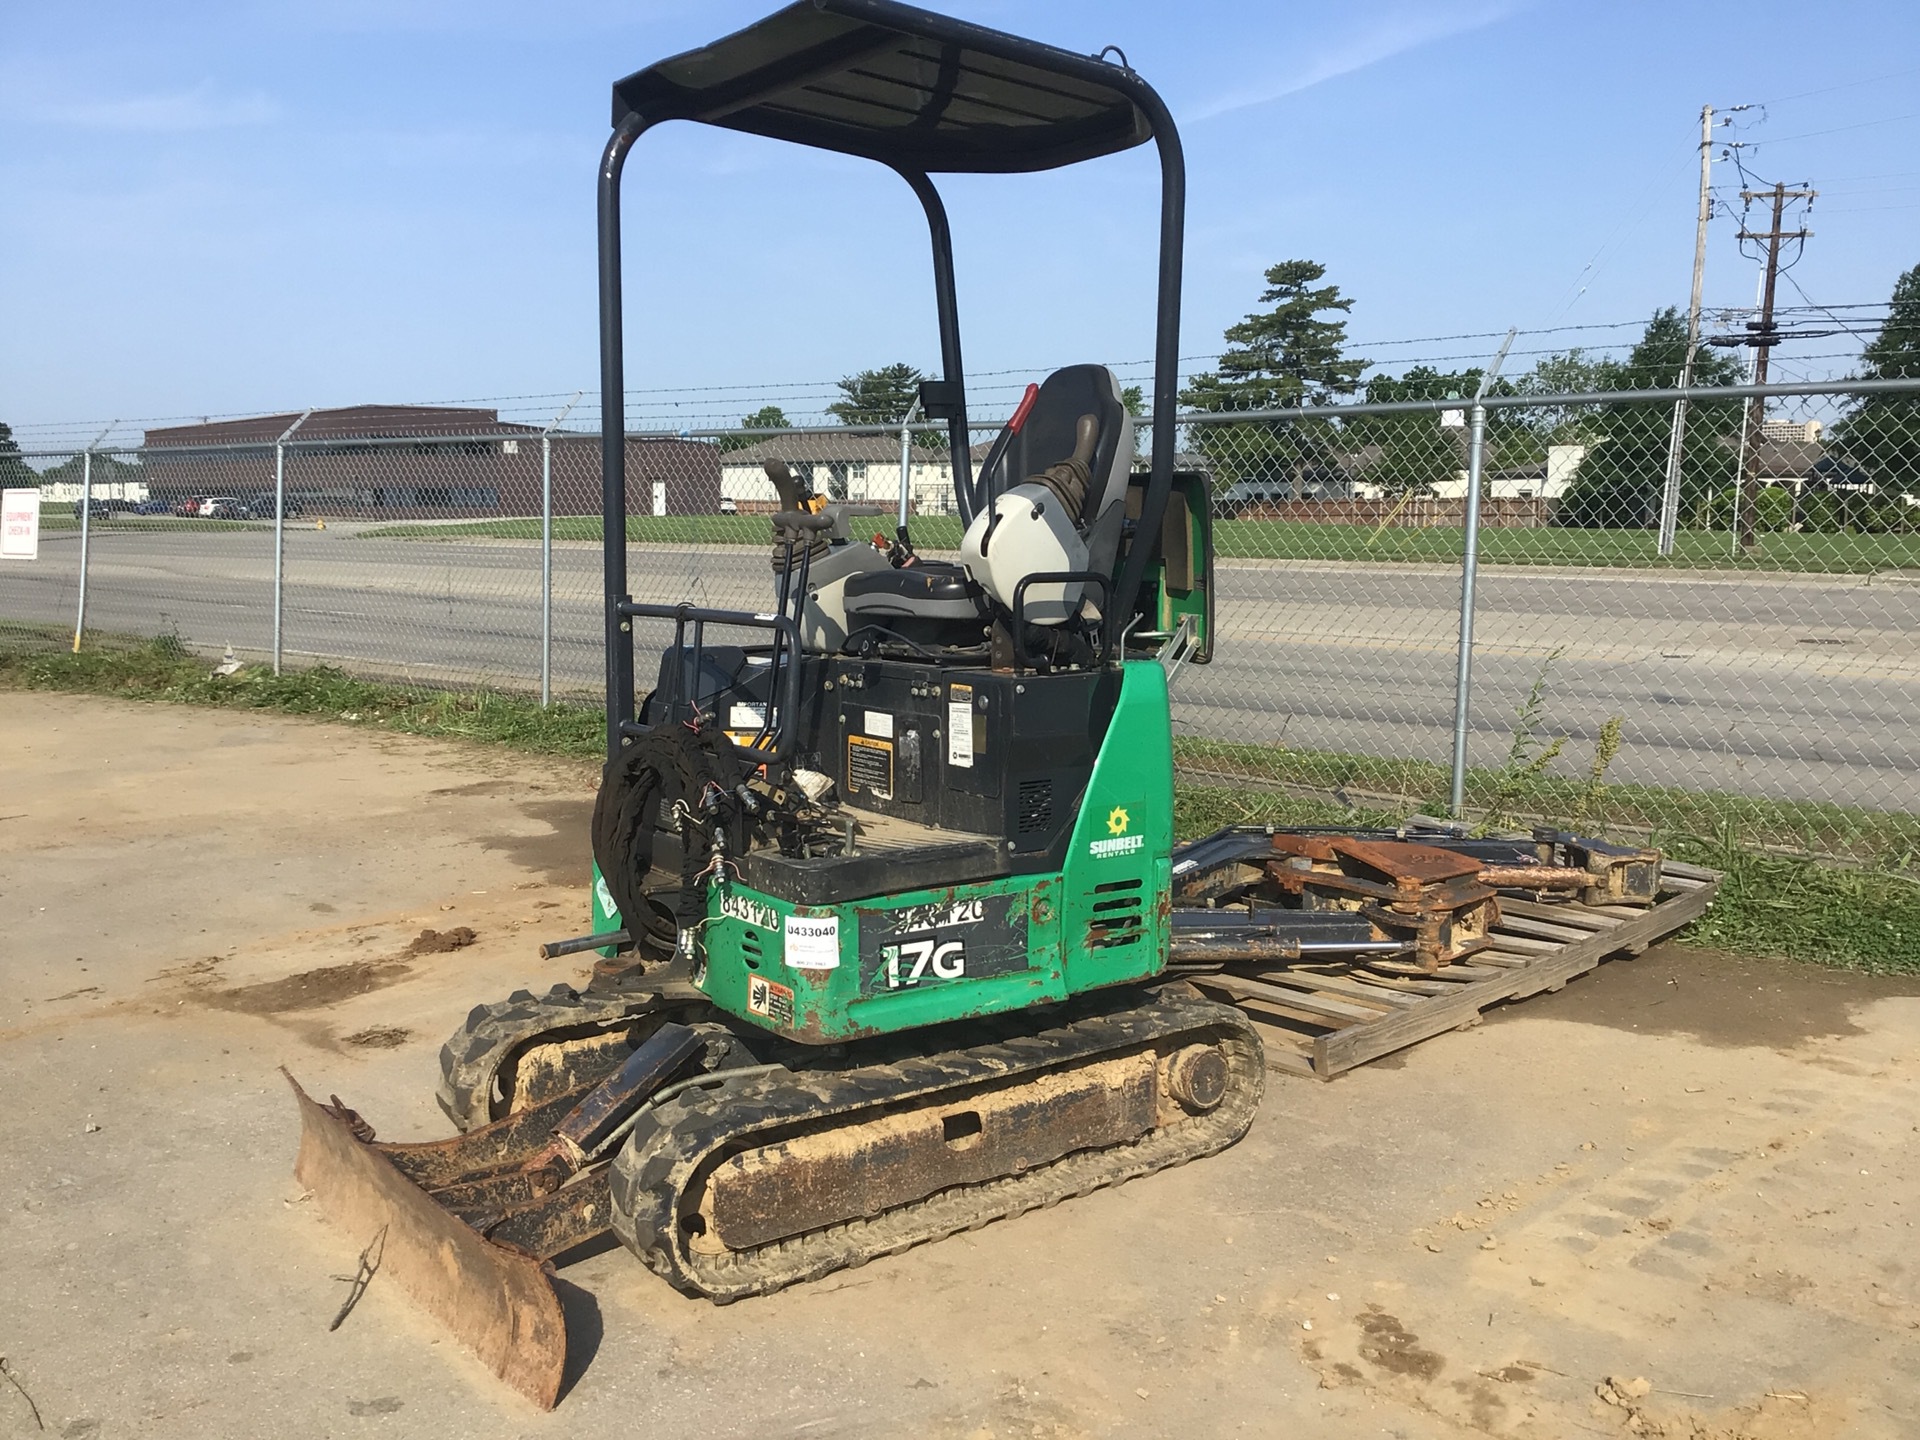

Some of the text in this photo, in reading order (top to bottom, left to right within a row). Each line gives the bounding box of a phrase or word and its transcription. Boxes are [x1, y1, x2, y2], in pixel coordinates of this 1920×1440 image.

[1090, 835, 1144, 854] SUNBELT
[1096, 849, 1136, 859] RENTALS
[882, 939, 965, 988] 17G
